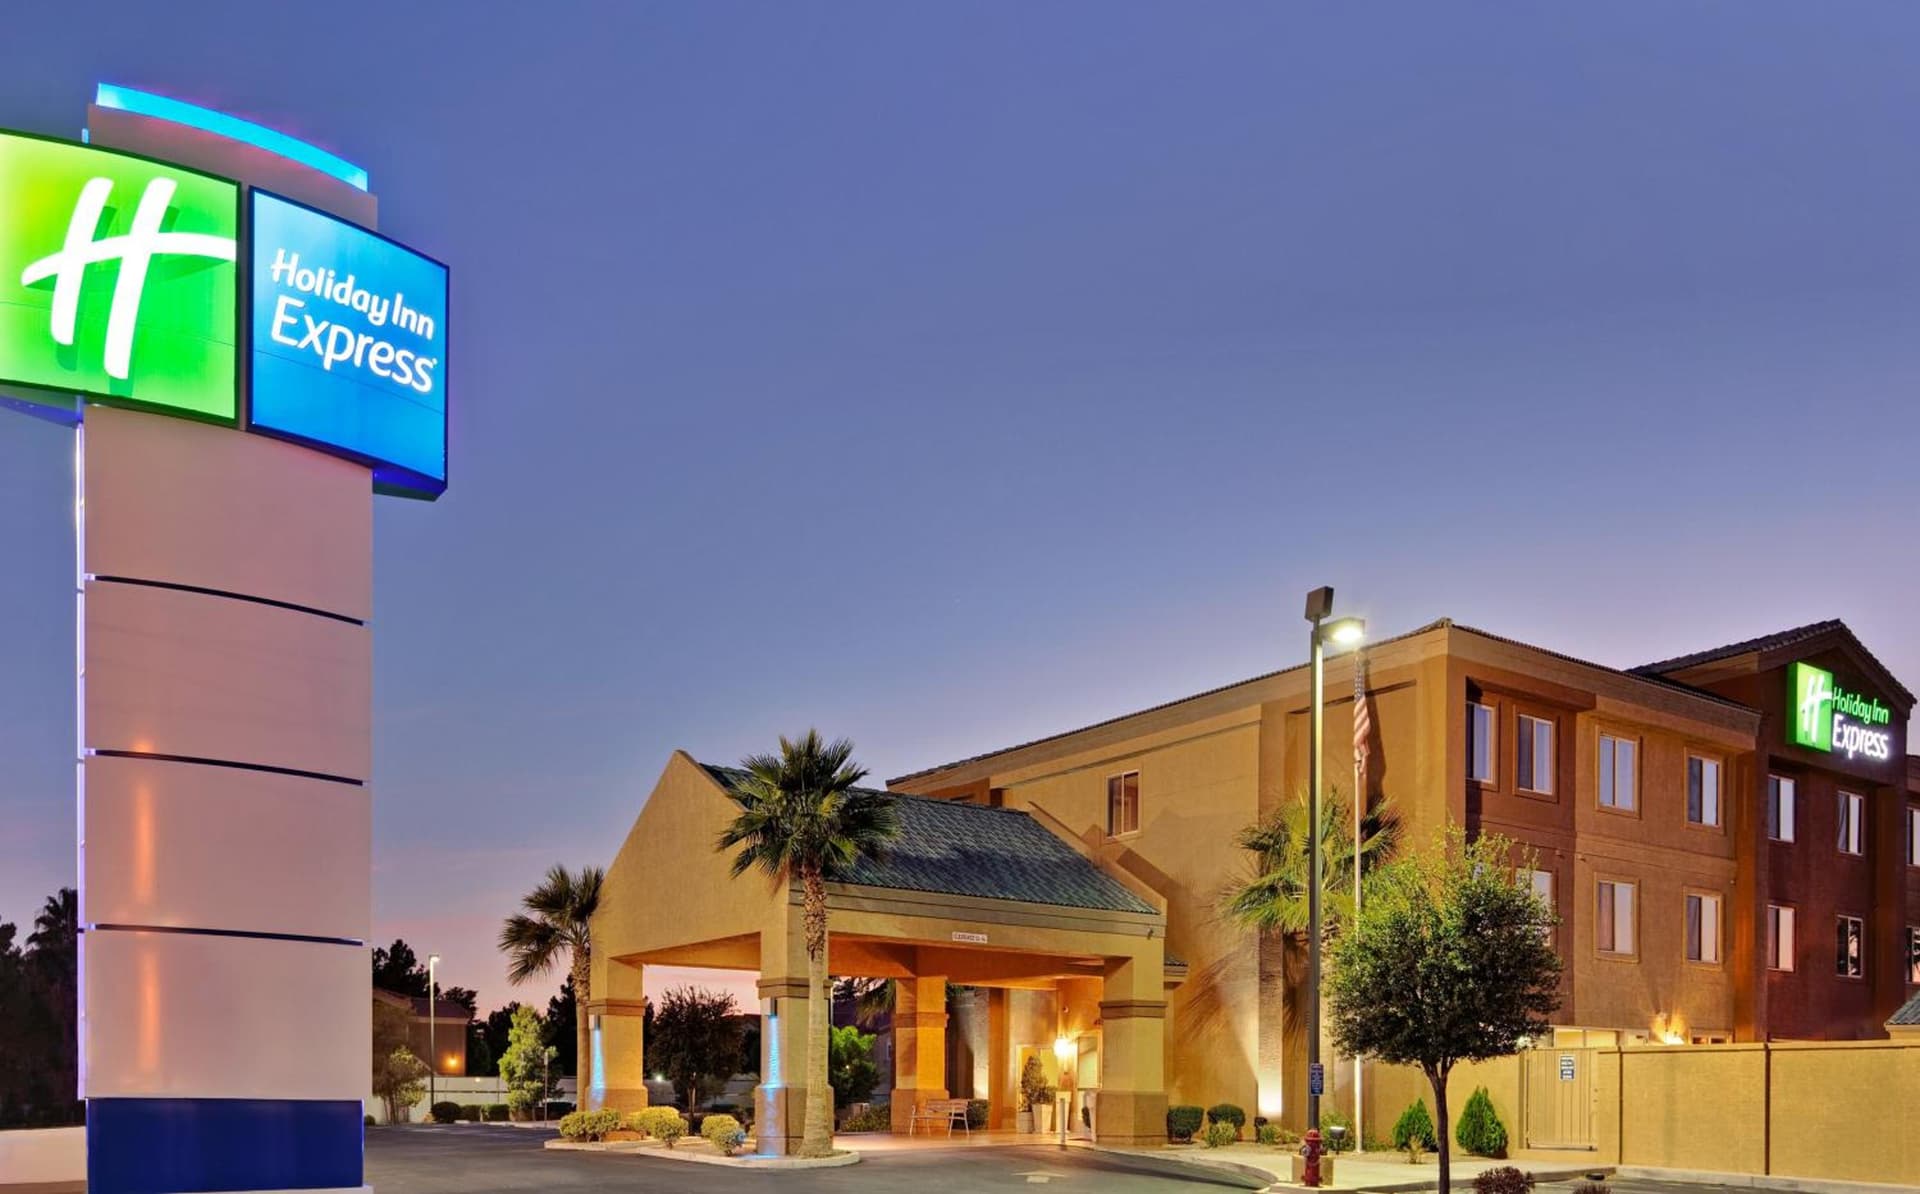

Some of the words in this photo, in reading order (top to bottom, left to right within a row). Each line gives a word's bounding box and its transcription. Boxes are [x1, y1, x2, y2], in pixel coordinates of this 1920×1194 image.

[271, 248, 389, 326] Holiday
[391, 292, 434, 340] Inn
[271, 294, 433, 393] Express
[1832, 686, 1872, 724] Holiday
[1872, 697, 1889, 725] Inn
[1832, 713, 1889, 759] Express
